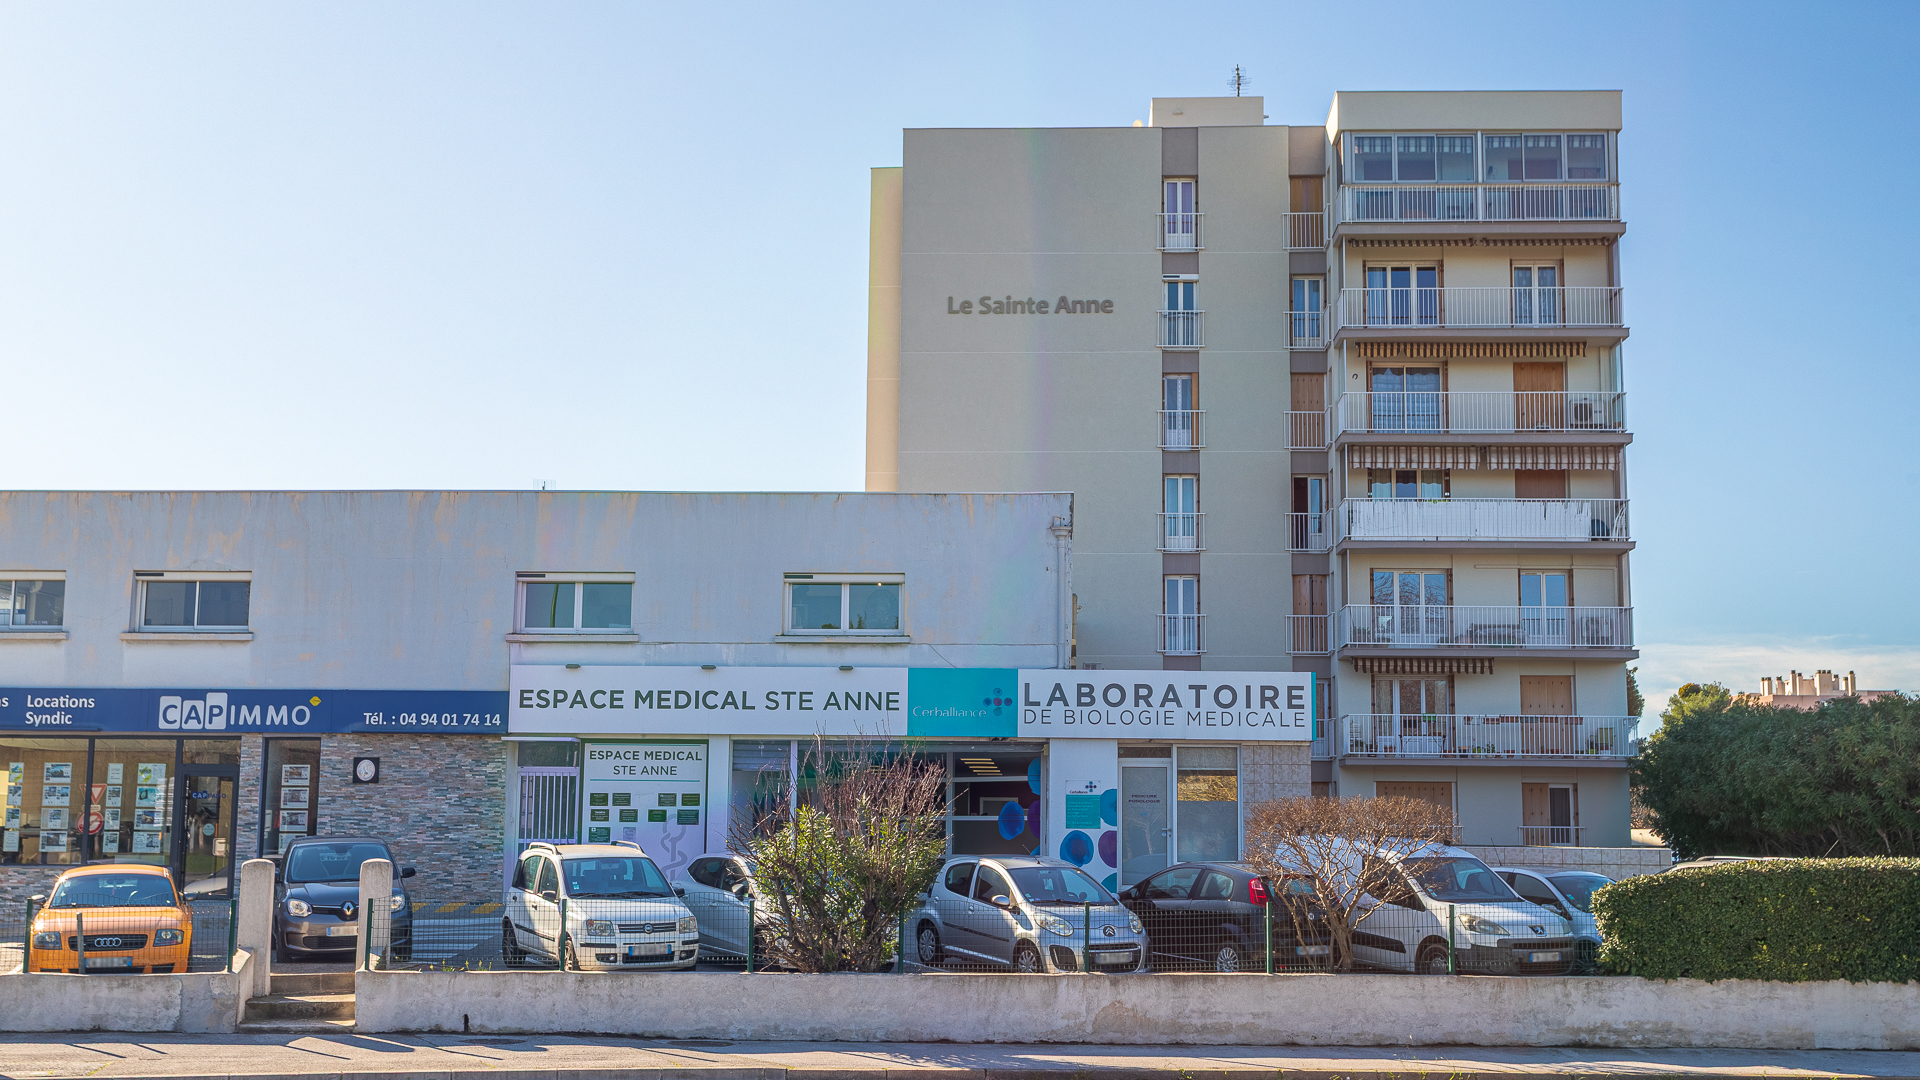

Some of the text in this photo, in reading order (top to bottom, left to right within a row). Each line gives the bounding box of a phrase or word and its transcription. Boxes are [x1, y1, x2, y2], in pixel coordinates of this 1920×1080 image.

[947, 295, 1114, 315] Le Sainte Anne
[27, 694, 96, 708] Locations
[519, 689, 900, 711] ESPACE MEDICAL STE ANNE
[1023, 683, 1306, 710] LABORATOIRE
[399, 712, 418, 726] 04
[420, 713, 439, 726] 94
[441, 713, 459, 726] 01
[463, 713, 480, 726] 74
[484, 713, 501, 726] 14
[912, 705, 987, 718] Cerballiance
[1023, 709, 1306, 728] DE BIOLOGIE MEDICALE
[25, 711, 73, 728] Syndic
[589, 750, 703, 761] ESPACE MEDICAL
[612, 765, 678, 776] STE ANNE
